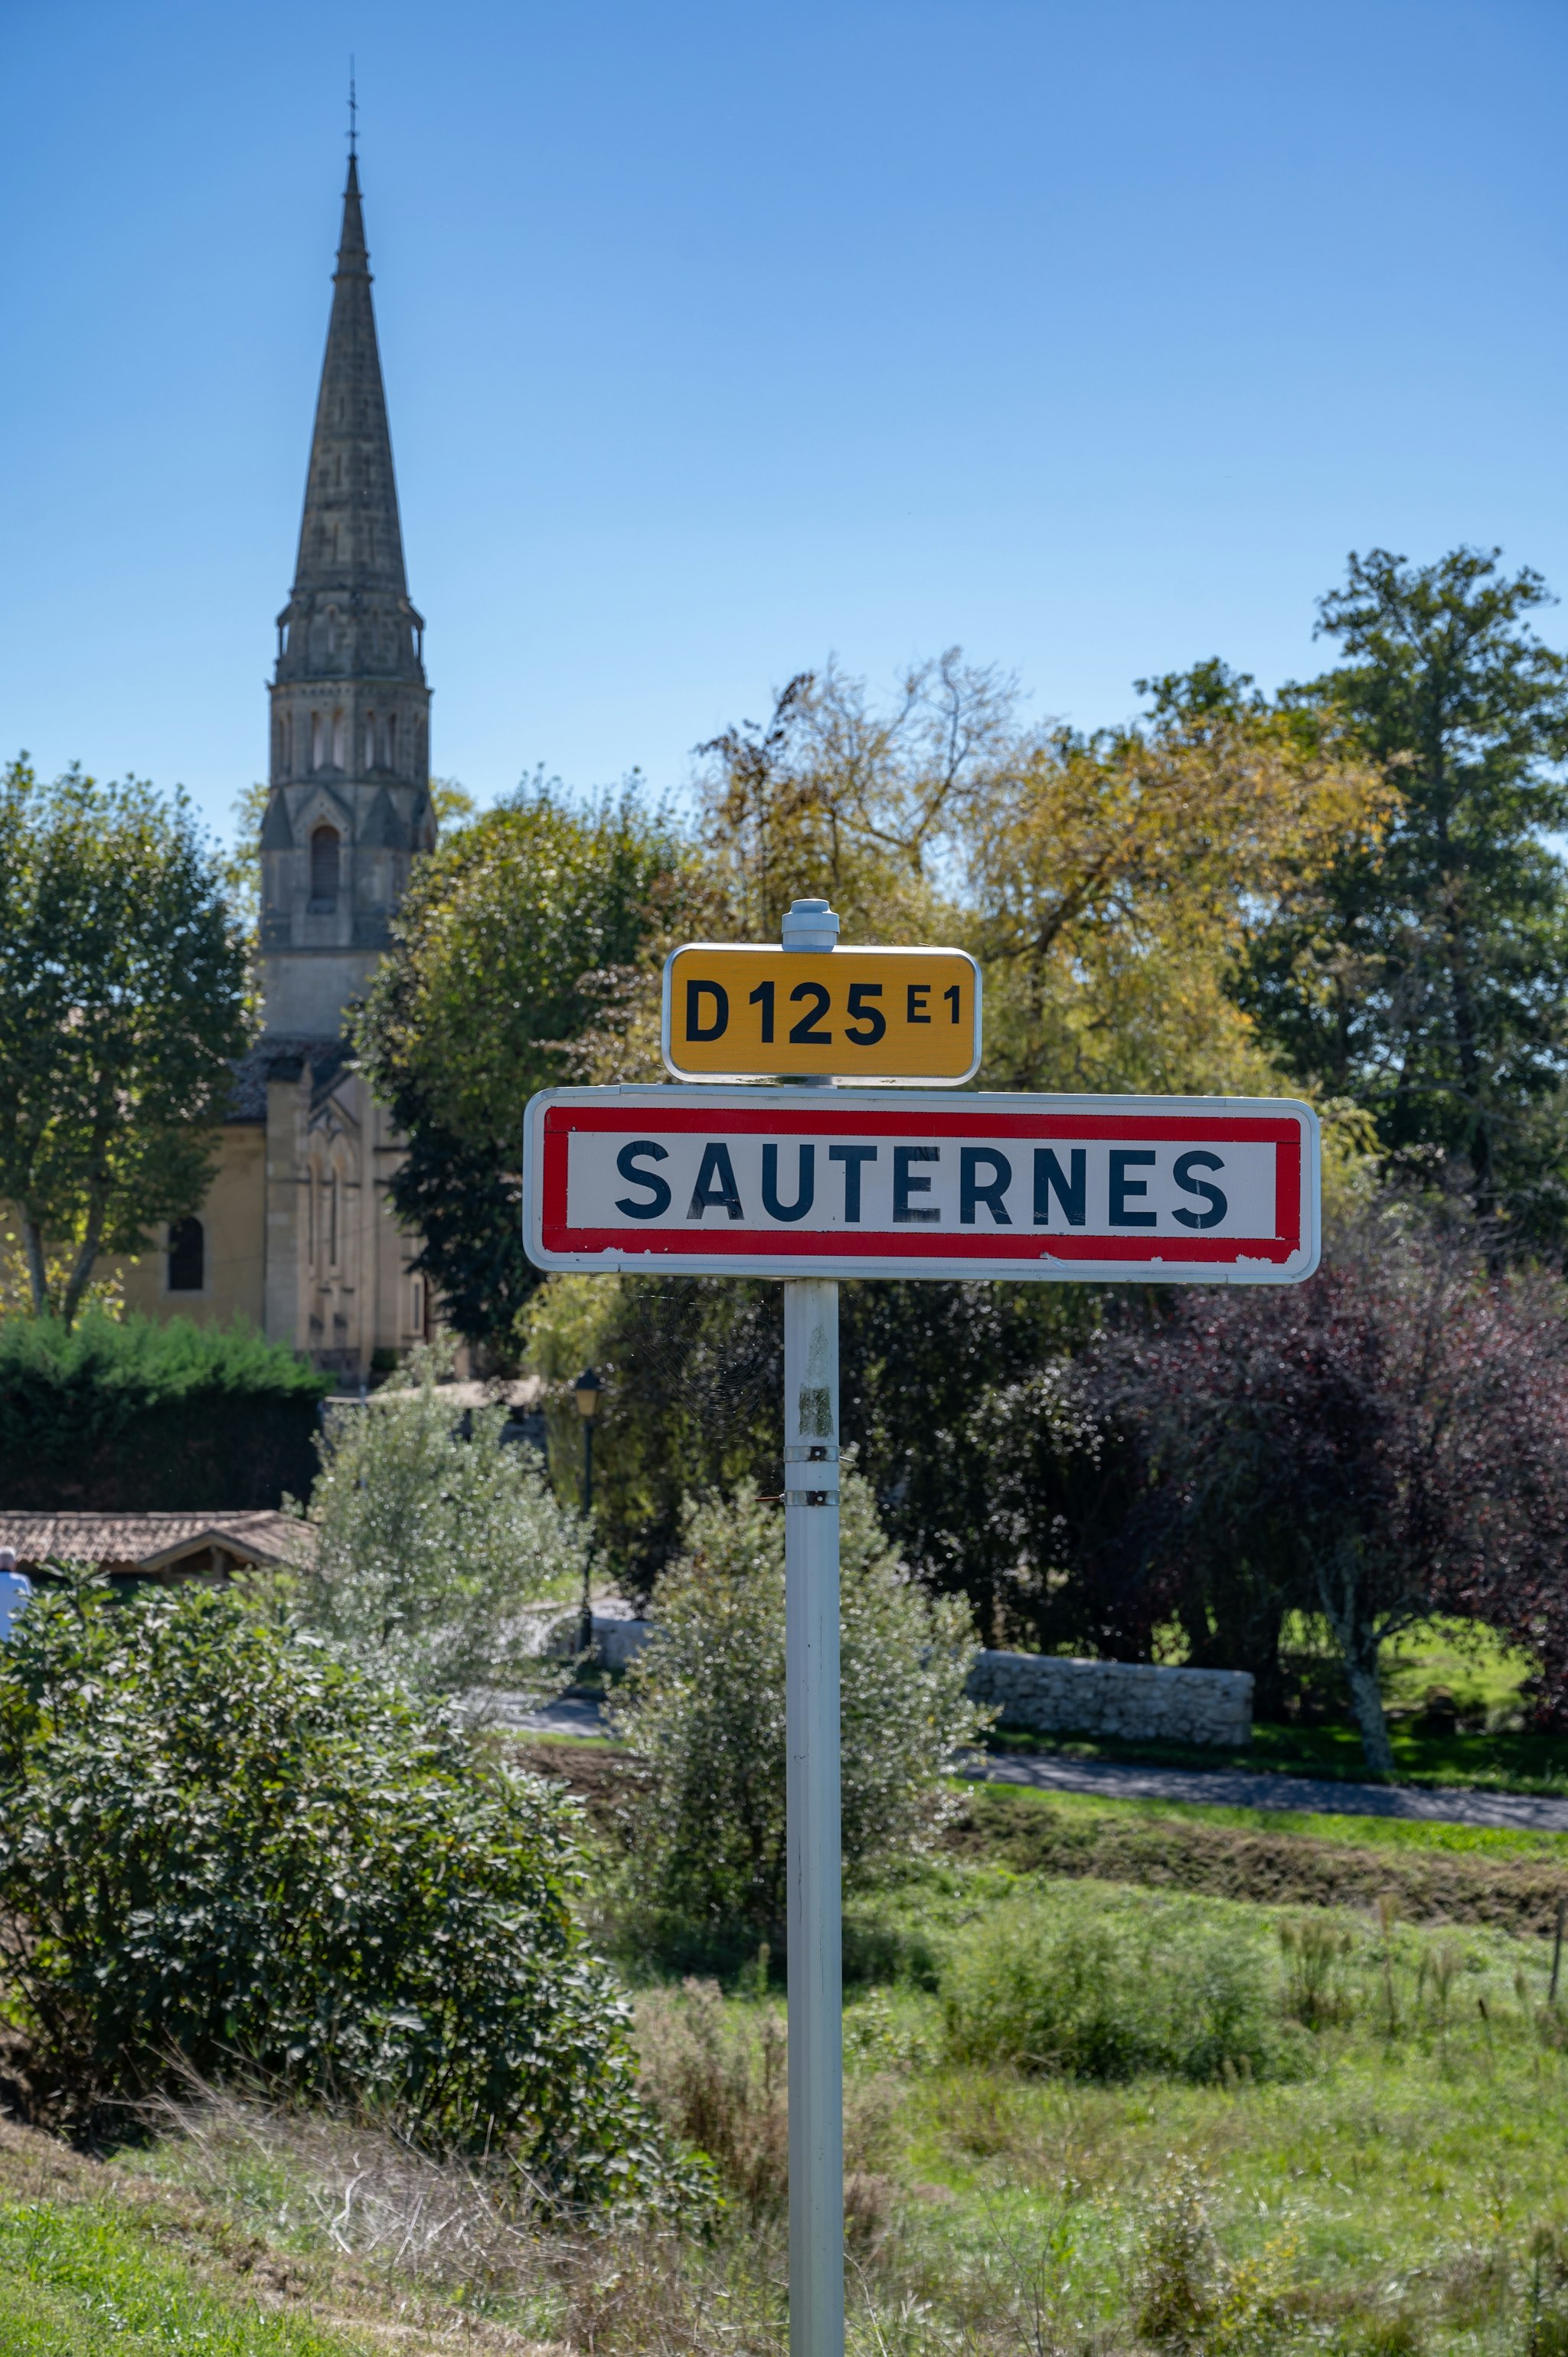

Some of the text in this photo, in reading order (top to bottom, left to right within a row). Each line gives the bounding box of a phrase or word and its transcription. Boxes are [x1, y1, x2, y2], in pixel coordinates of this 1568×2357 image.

[686, 980, 960, 1046] D 125 E1
[615, 1139, 1227, 1229] SAUTERNES
